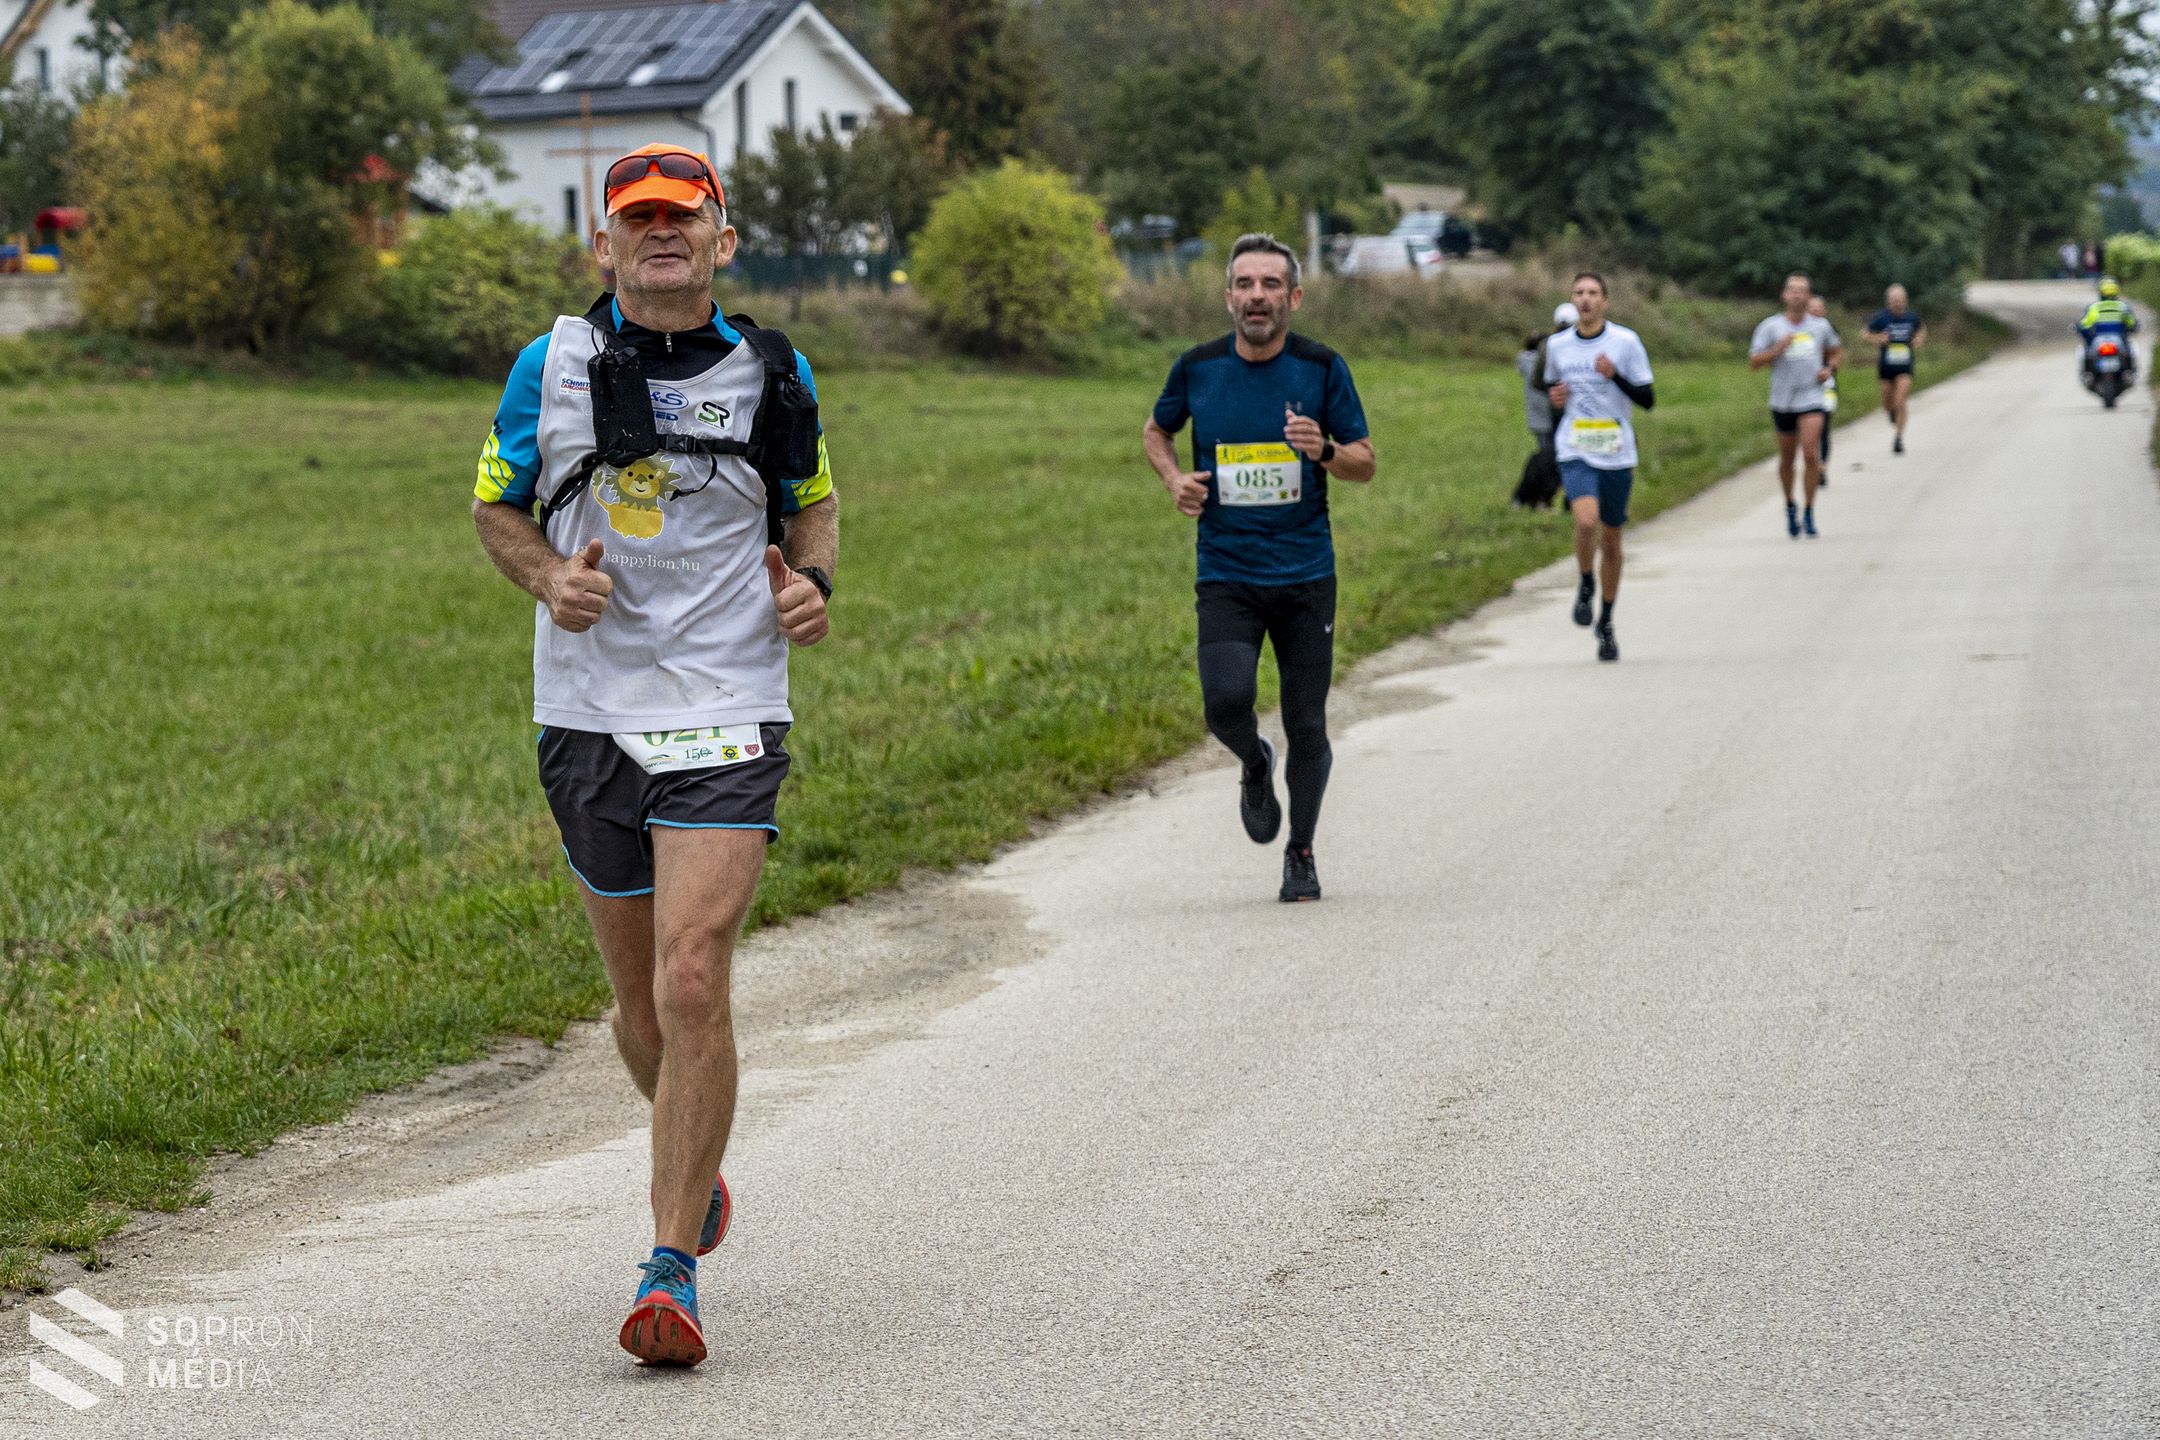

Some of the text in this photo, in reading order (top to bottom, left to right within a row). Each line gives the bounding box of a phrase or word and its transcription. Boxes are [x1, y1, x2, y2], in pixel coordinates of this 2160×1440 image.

[651, 391, 683, 406] &S
[653, 411, 679, 421] ED
[1236, 467, 1283, 488] 085
